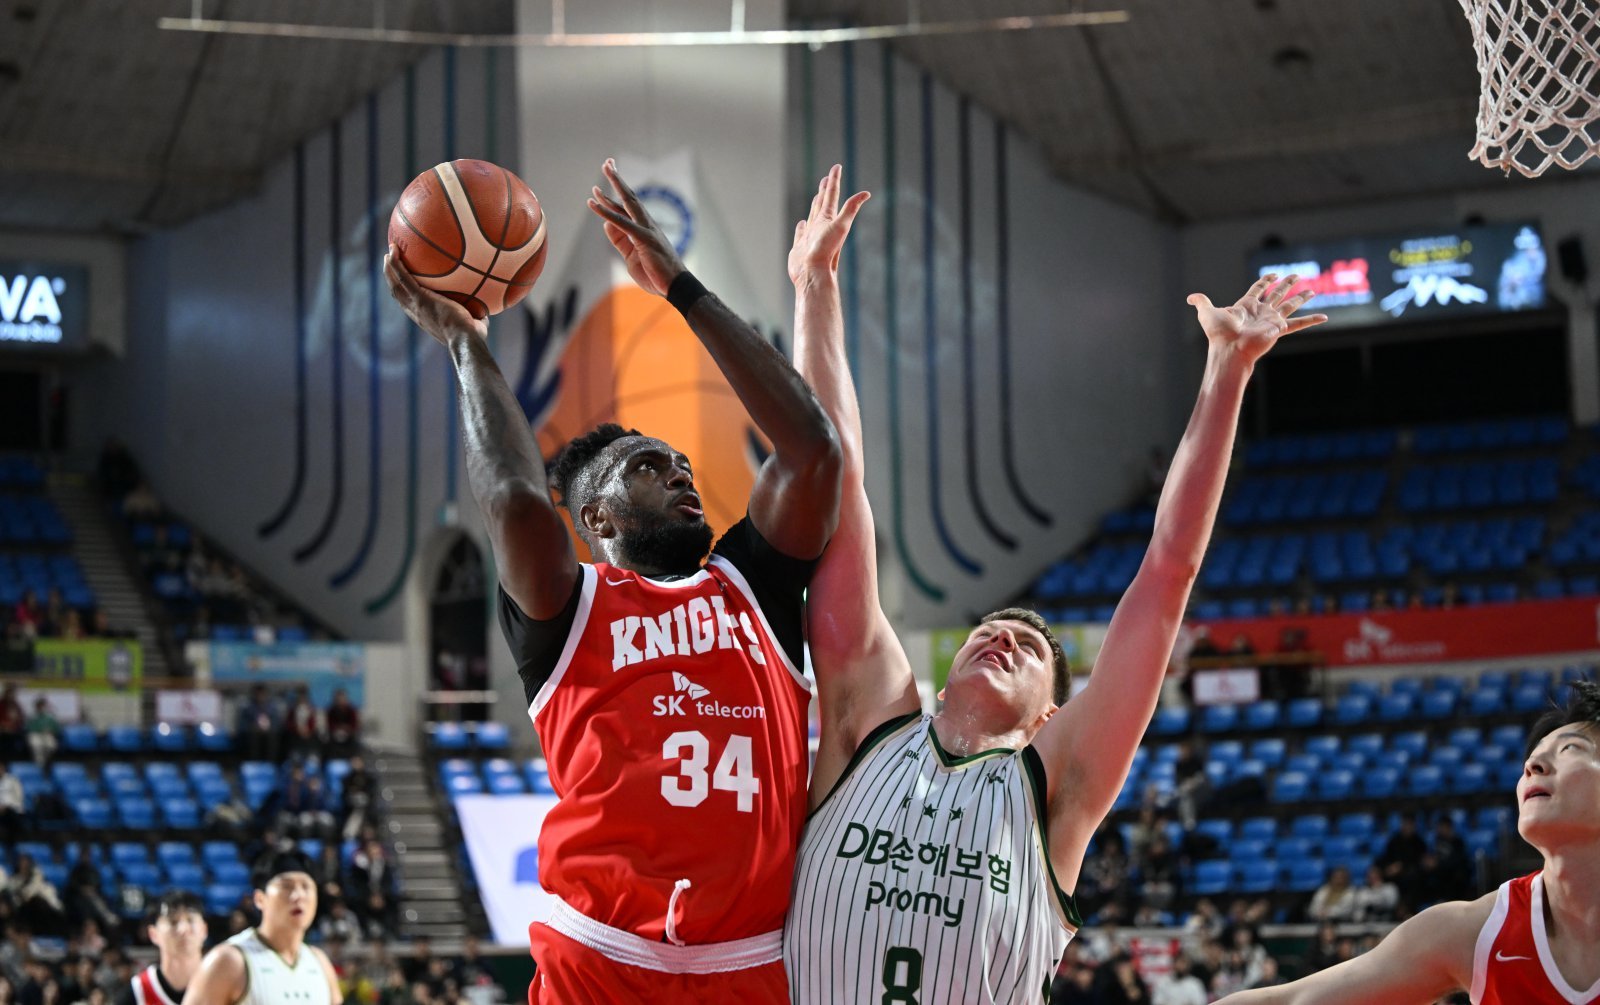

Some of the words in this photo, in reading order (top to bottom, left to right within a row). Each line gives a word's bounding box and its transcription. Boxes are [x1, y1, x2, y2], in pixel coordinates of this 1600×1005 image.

[610, 595, 767, 673] KNIGHS
[652, 694, 686, 716] SK
[696, 700, 766, 720] telecom
[660, 730, 760, 813] 34
[836, 821, 1012, 895] DB손해보험
[881, 946, 923, 1005] 8
